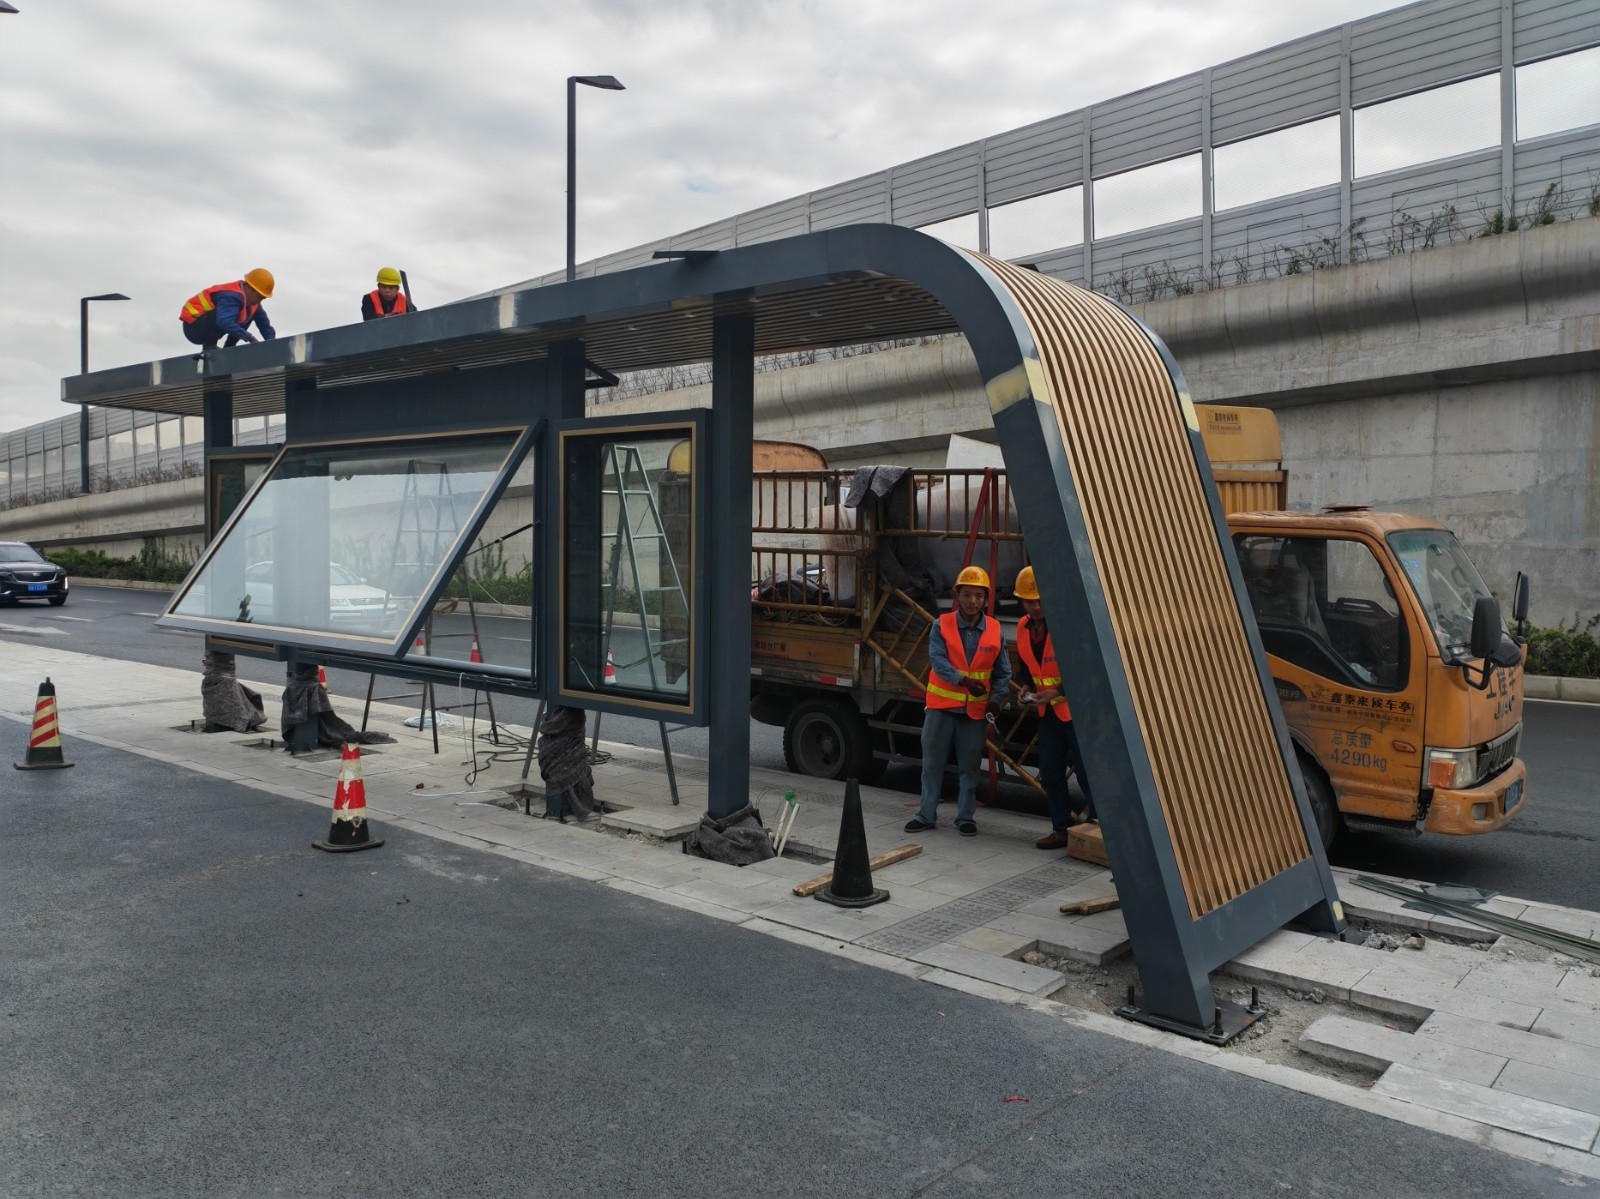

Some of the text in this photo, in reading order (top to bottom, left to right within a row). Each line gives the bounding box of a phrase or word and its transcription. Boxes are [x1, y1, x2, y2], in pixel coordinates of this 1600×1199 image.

[1331, 692, 1412, 711] 鑫泰来候车亭
[1494, 693, 1515, 720] JAC
[1331, 730, 1372, 748] 总质量
[1330, 748, 1387, 772] 4290kg
